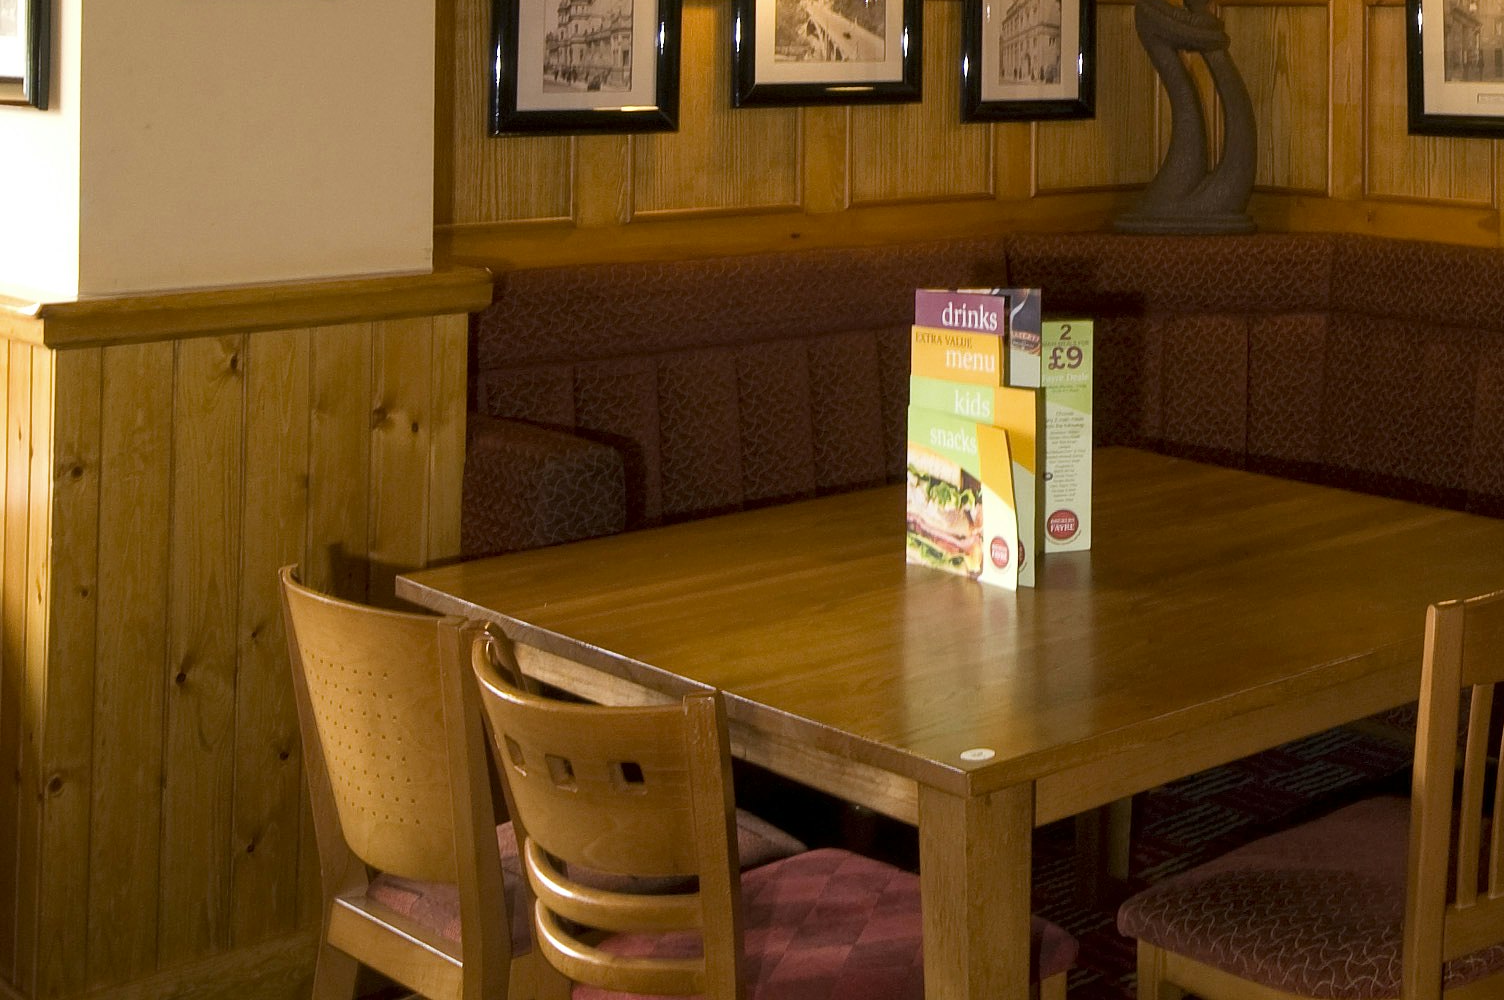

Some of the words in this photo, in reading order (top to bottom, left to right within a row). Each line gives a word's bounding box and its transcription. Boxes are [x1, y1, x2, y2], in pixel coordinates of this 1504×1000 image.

[942, 301, 998, 331] drinks
[915, 332, 943, 345] EXTRA
[945, 335, 973, 349] VALUE
[1060, 324, 1072, 340] 2
[945, 348, 995, 372] menu
[1048, 345, 1083, 370] £9
[954, 389, 991, 417] kids
[930, 427, 977, 454] snacks
